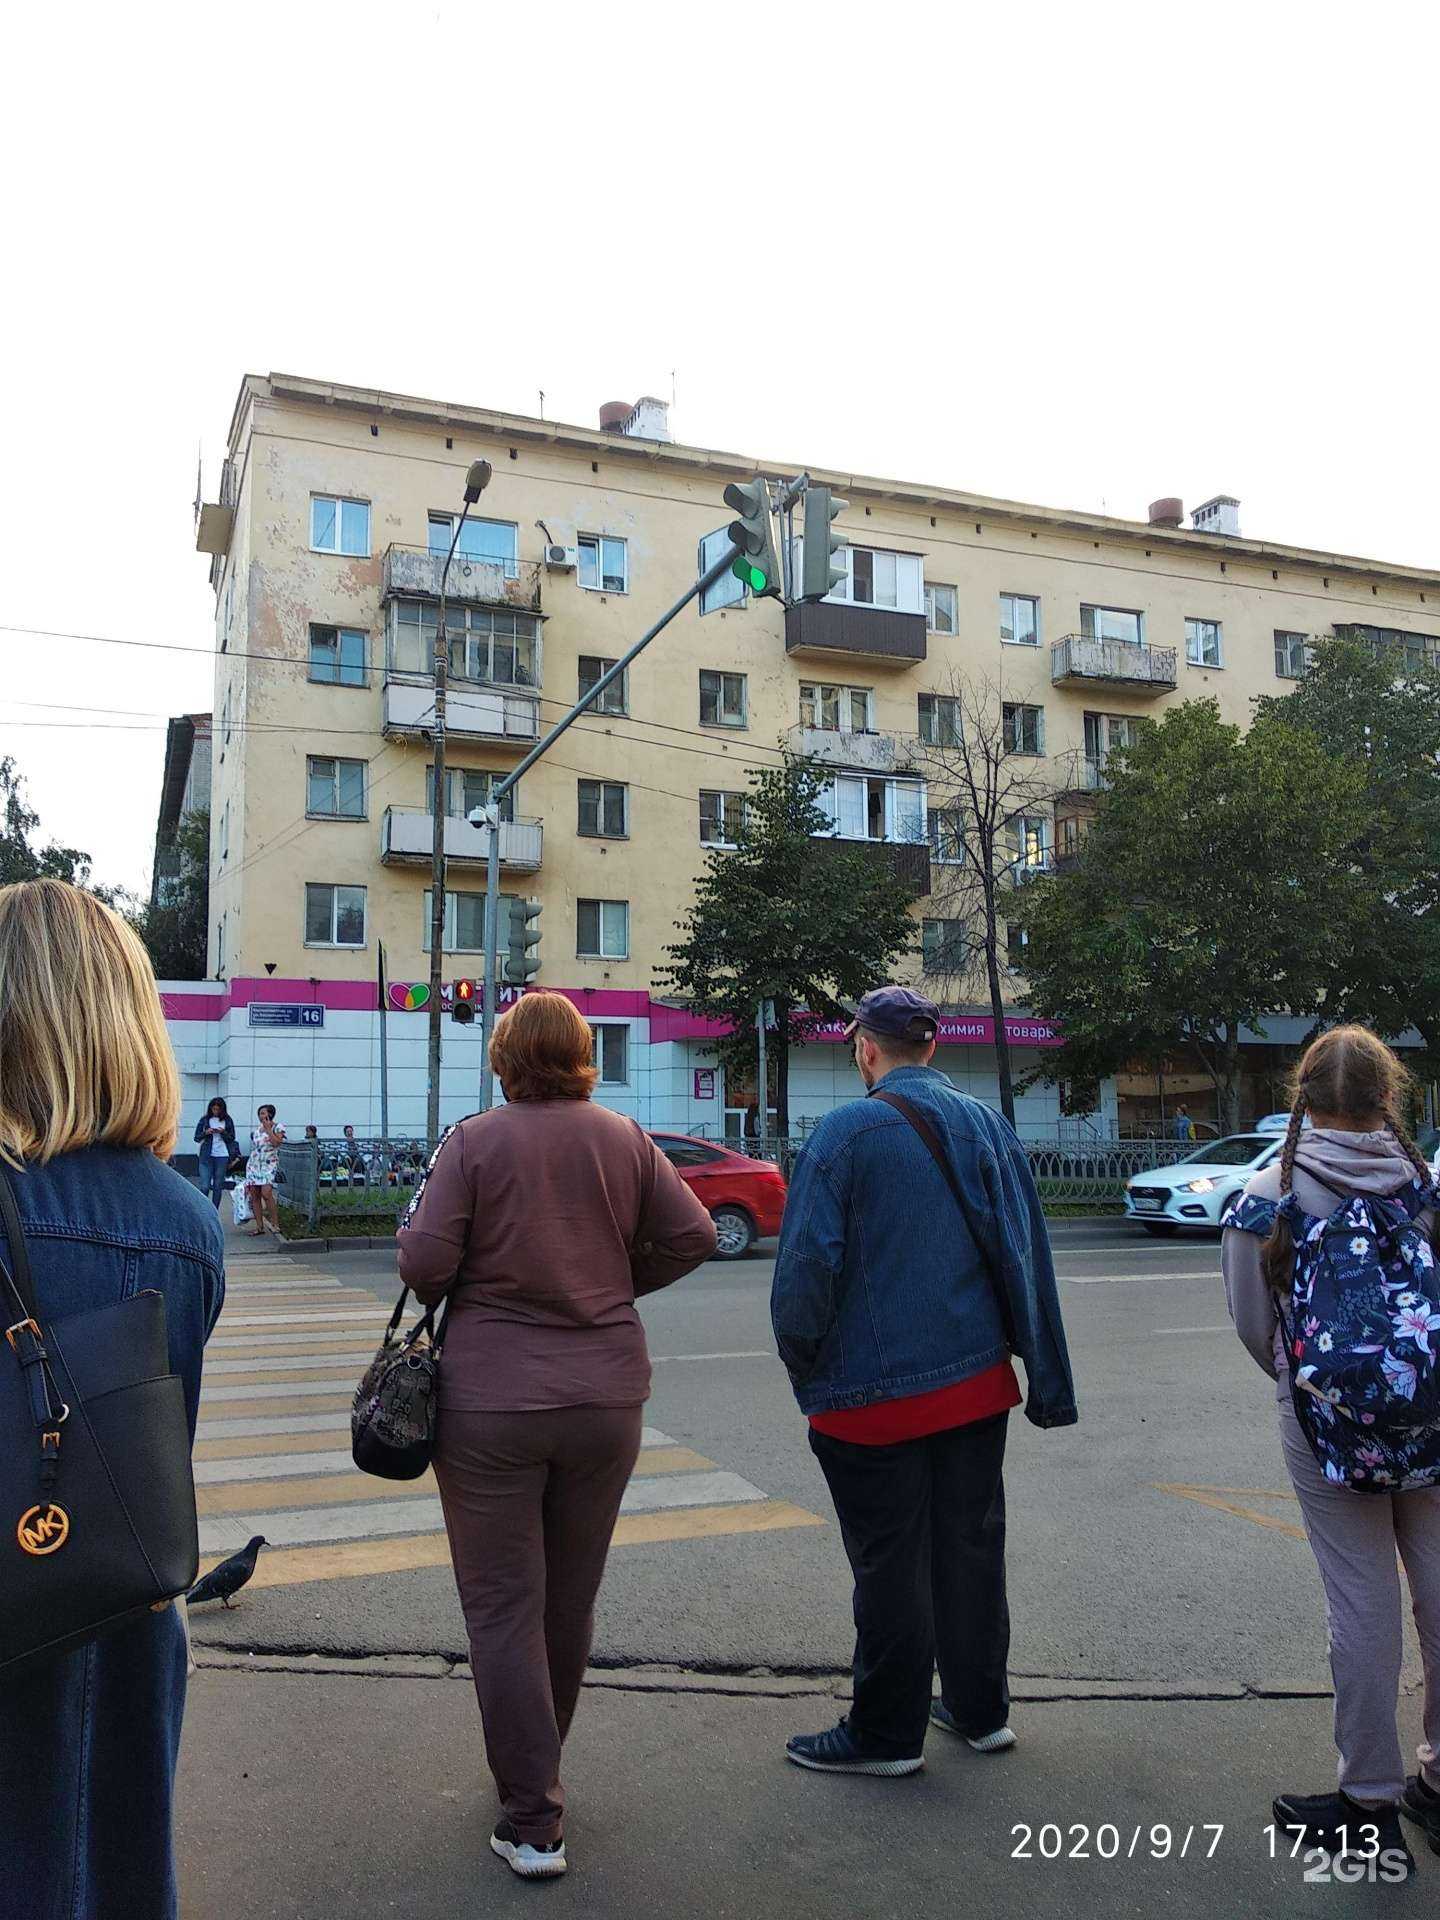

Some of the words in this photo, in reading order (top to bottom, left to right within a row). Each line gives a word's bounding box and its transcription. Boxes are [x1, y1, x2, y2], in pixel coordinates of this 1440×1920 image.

[302, 1009, 320, 1023] 16
[939, 1024, 985, 1036] химия
[22, 1510, 65, 1548] MK
